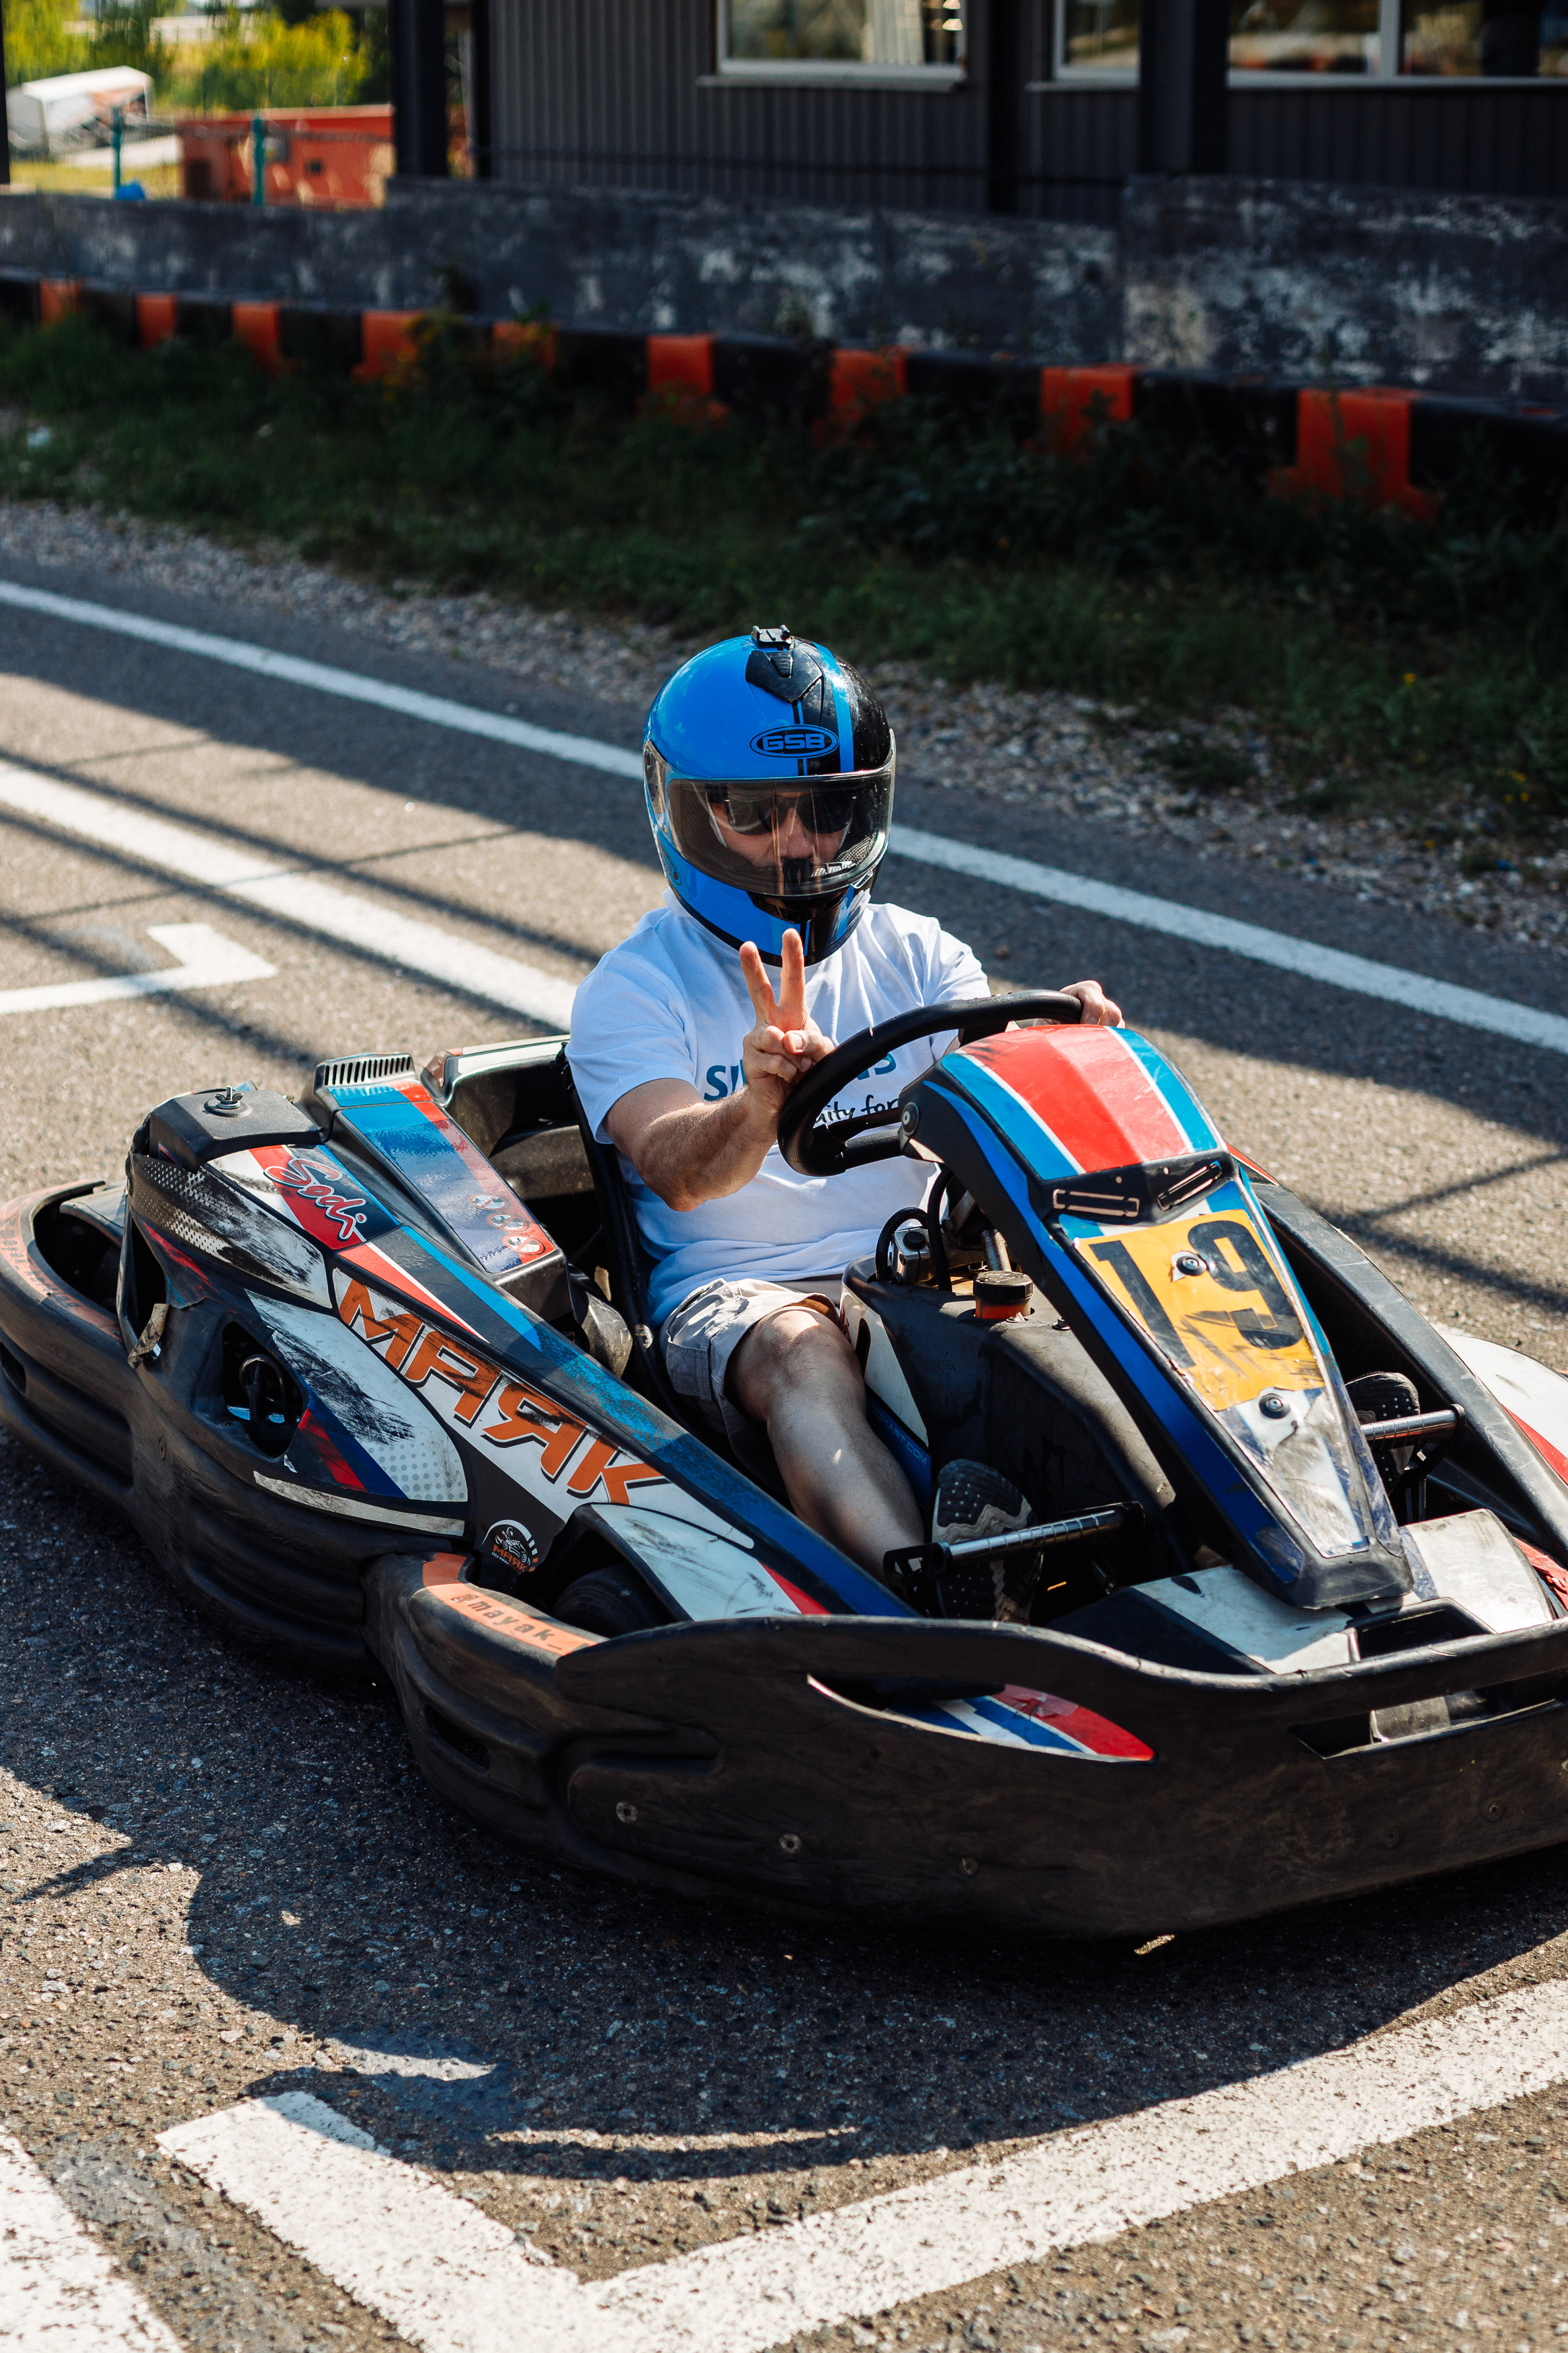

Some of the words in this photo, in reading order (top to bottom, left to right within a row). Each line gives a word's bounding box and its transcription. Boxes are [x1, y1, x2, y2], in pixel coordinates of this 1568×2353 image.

[763, 733, 825, 751] GSB
[264, 1158, 367, 1240] Sodi
[1088, 1220, 1305, 1369] 19
[338, 1278, 667, 1505] МАЯК
[870, 1403, 927, 1466] ODIKART.COM
